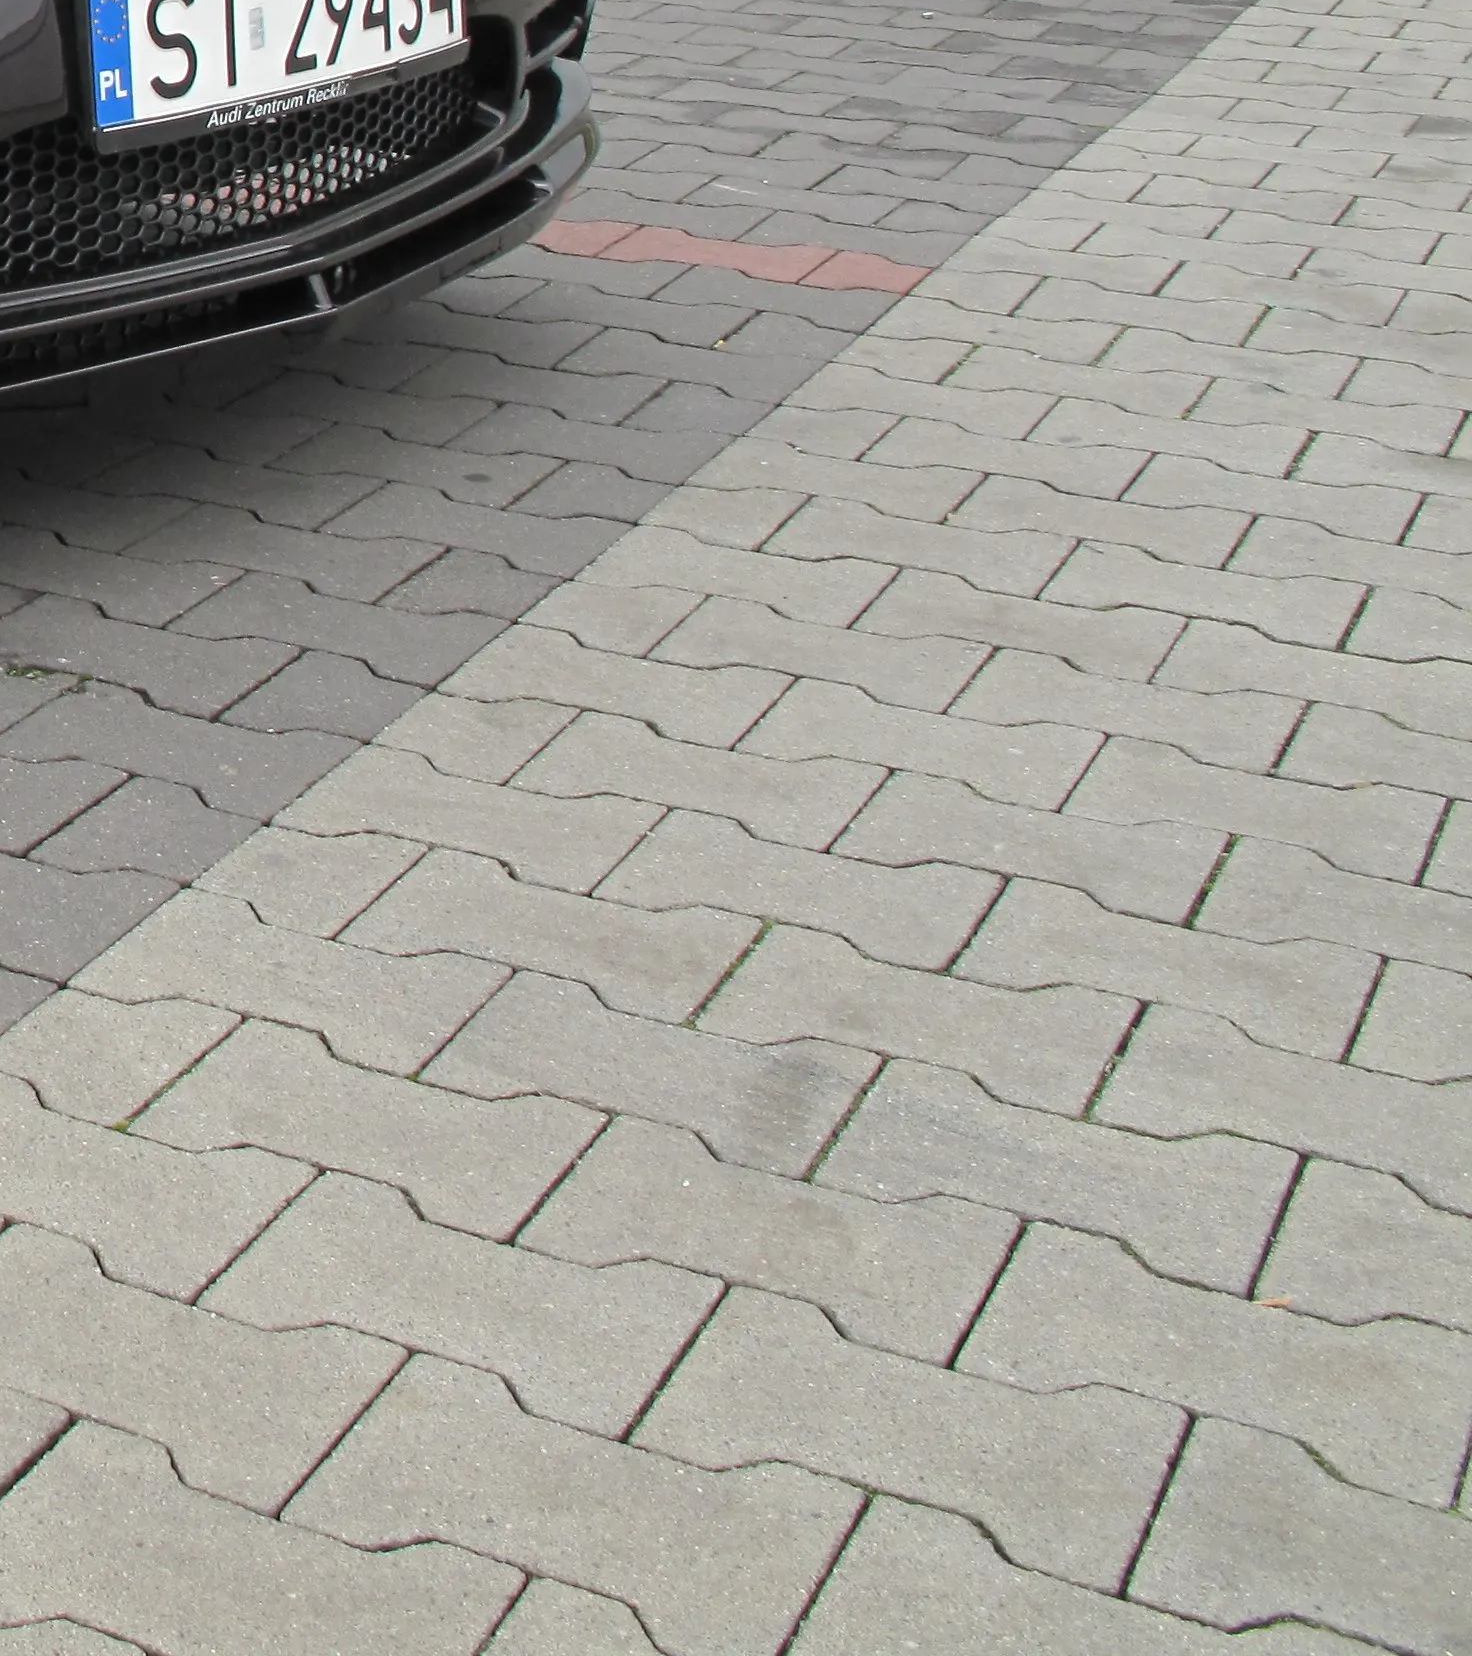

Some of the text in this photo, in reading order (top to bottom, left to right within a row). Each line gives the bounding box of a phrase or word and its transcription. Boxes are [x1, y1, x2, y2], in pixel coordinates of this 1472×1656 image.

[99, 69, 129, 102] PL
[207, 105, 244, 128] Audi
[245, 93, 304, 120] Zentrum
